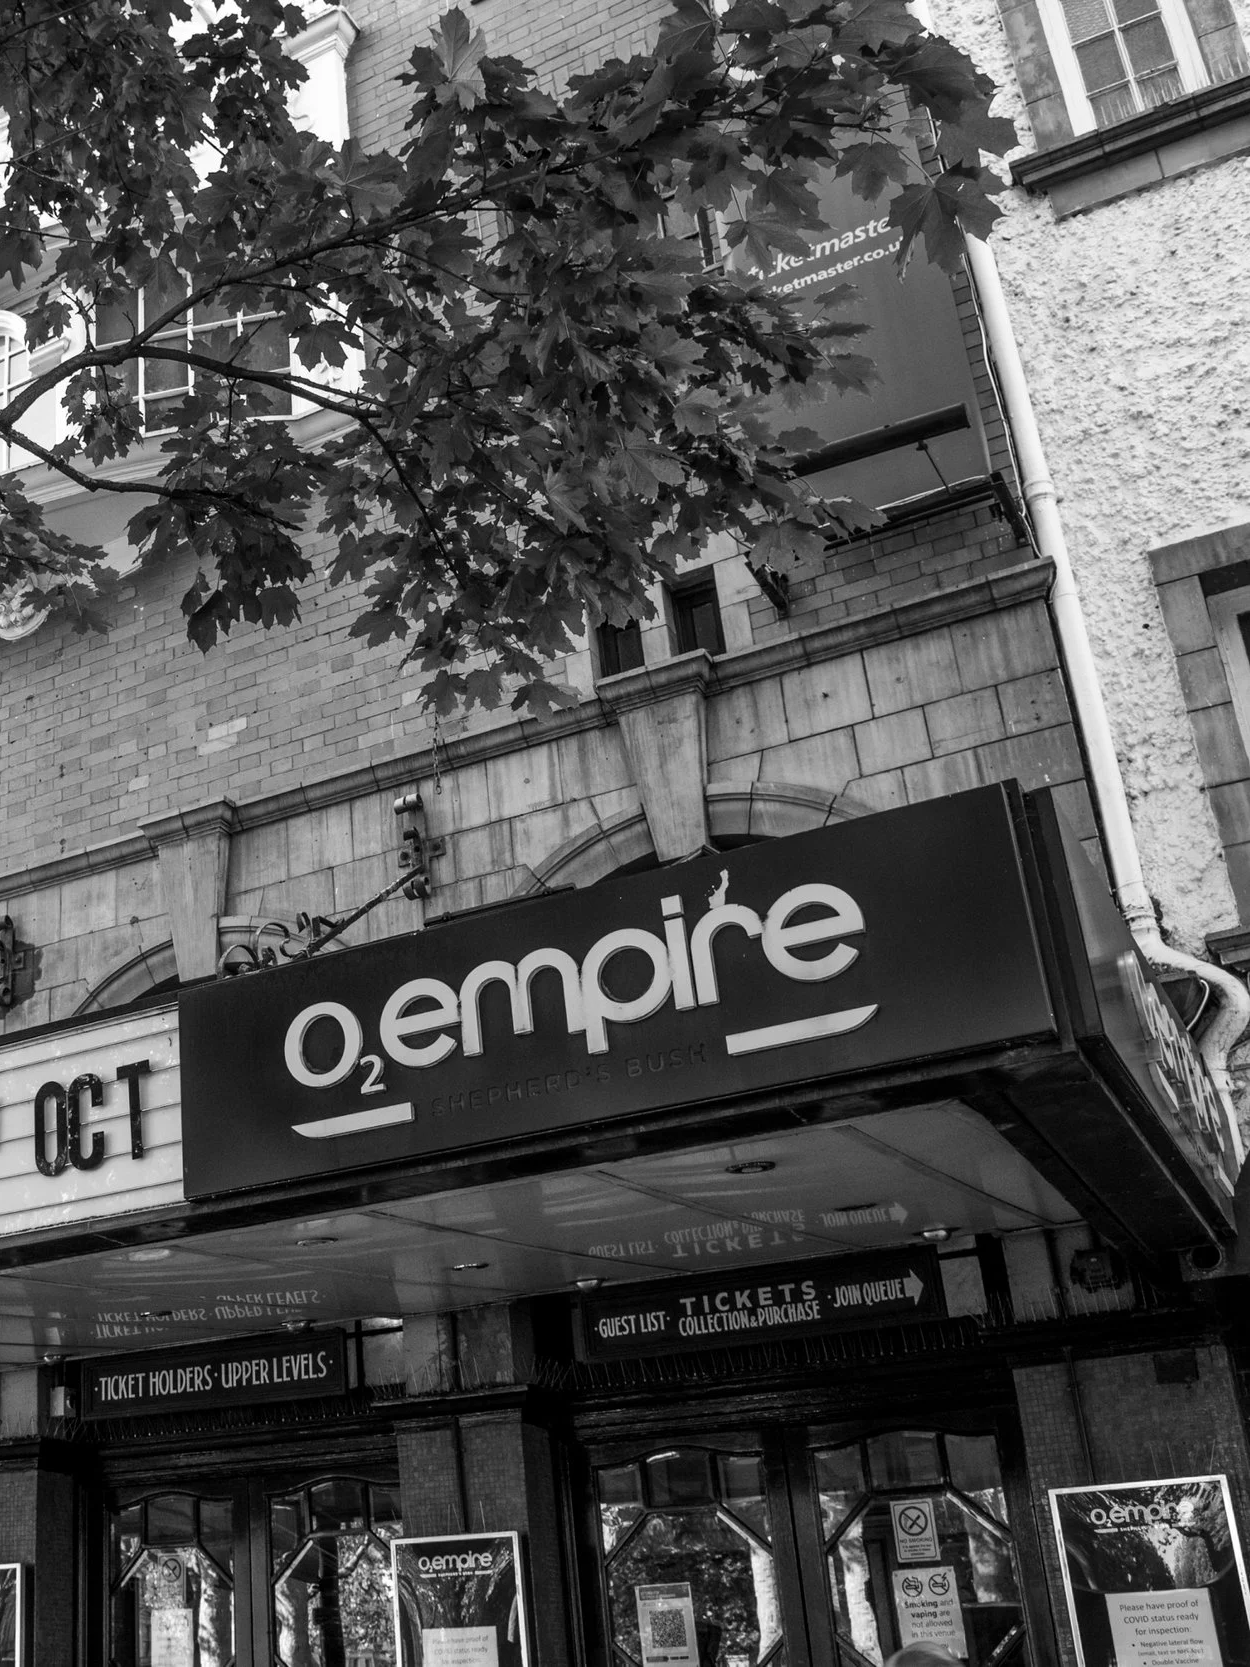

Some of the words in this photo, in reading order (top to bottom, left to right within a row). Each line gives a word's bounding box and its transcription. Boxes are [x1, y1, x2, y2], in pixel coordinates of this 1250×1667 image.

[431, 1063, 611, 1115] SHEPHERD'S
[626, 1042, 708, 1079] BUSH
[34, 1059, 151, 1177] OCT
[679, 1280, 817, 1316] TICKETS
[833, 1286, 862, 1308] JOIN
[863, 1279, 904, 1306] QUEUE
[599, 1316, 637, 1338] GUEST
[639, 1311, 666, 1333] LIST
[99, 1373, 145, 1401] TICKET
[149, 1364, 213, 1397] HOLDERS
[221, 1359, 270, 1389] UPPER
[272, 1351, 327, 1383] LEVELS
[904, 1600, 938, 1609] Smoking
[1119, 1603, 1144, 1612] Please
[1146, 1602, 1165, 1610] have
[1167, 1600, 1189, 1610] proof
[1190, 1599, 1199, 1607] of
[911, 1610, 938, 1619] vaping
[1123, 1615, 1149, 1624] COVID
[1150, 1614, 1175, 1622] status
[1177, 1612, 1199, 1621] ready
[925, 1618, 953, 1628] allowed
[911, 1630, 919, 1638] in
[1135, 1628, 1147, 1636] for
[1140, 1641, 1168, 1649] Negative
[1175, 1657, 1199, 1665] Vaccine
